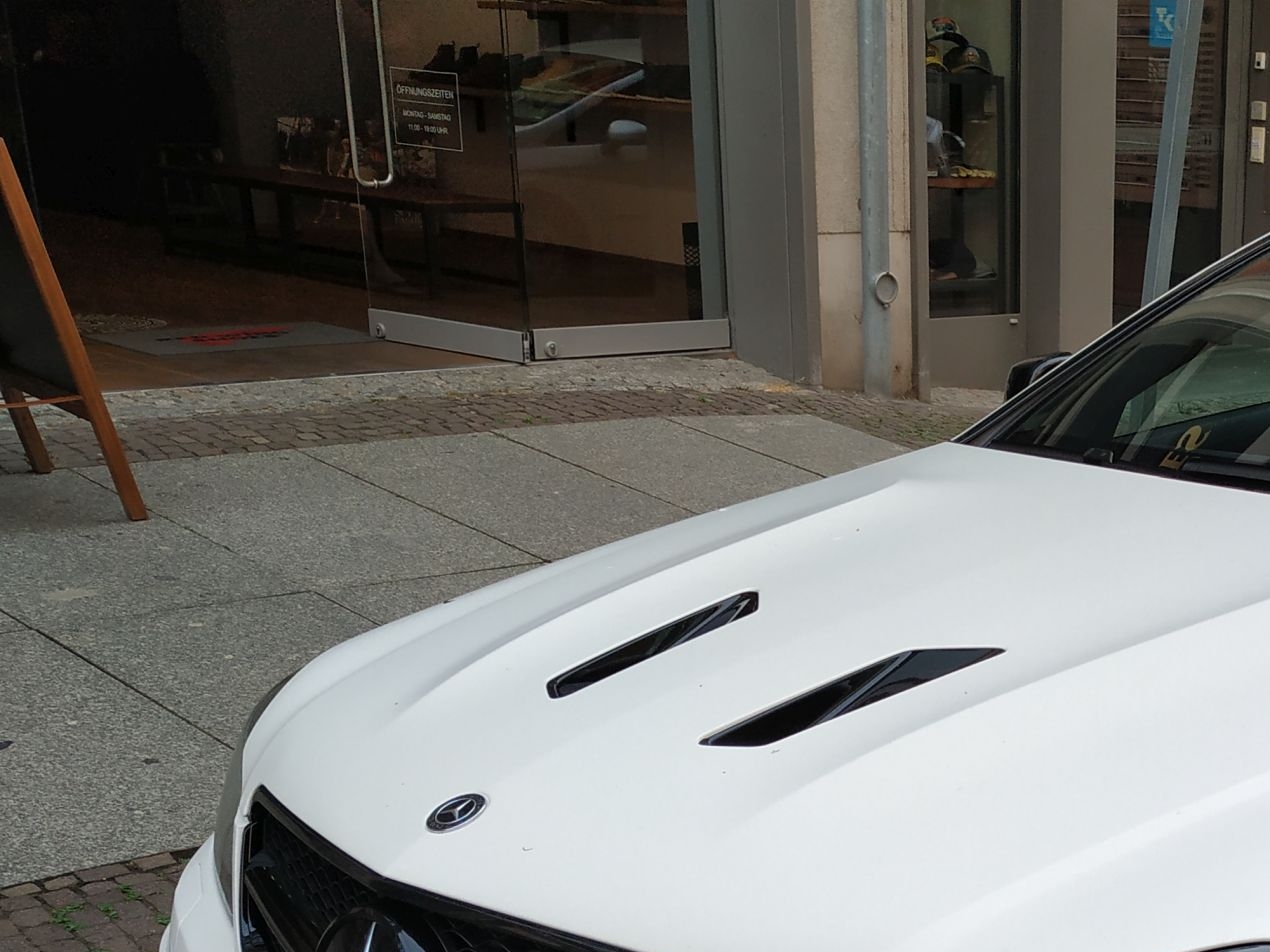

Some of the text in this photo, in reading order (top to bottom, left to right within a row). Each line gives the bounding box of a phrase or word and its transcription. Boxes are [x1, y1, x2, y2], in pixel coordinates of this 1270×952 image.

[396, 84, 454, 99] ÖFFNUNGSZEITEN
[402, 109, 424, 119] MONTAG
[427, 112, 451, 122] SAMSTAG
[436, 126, 449, 135] UHR
